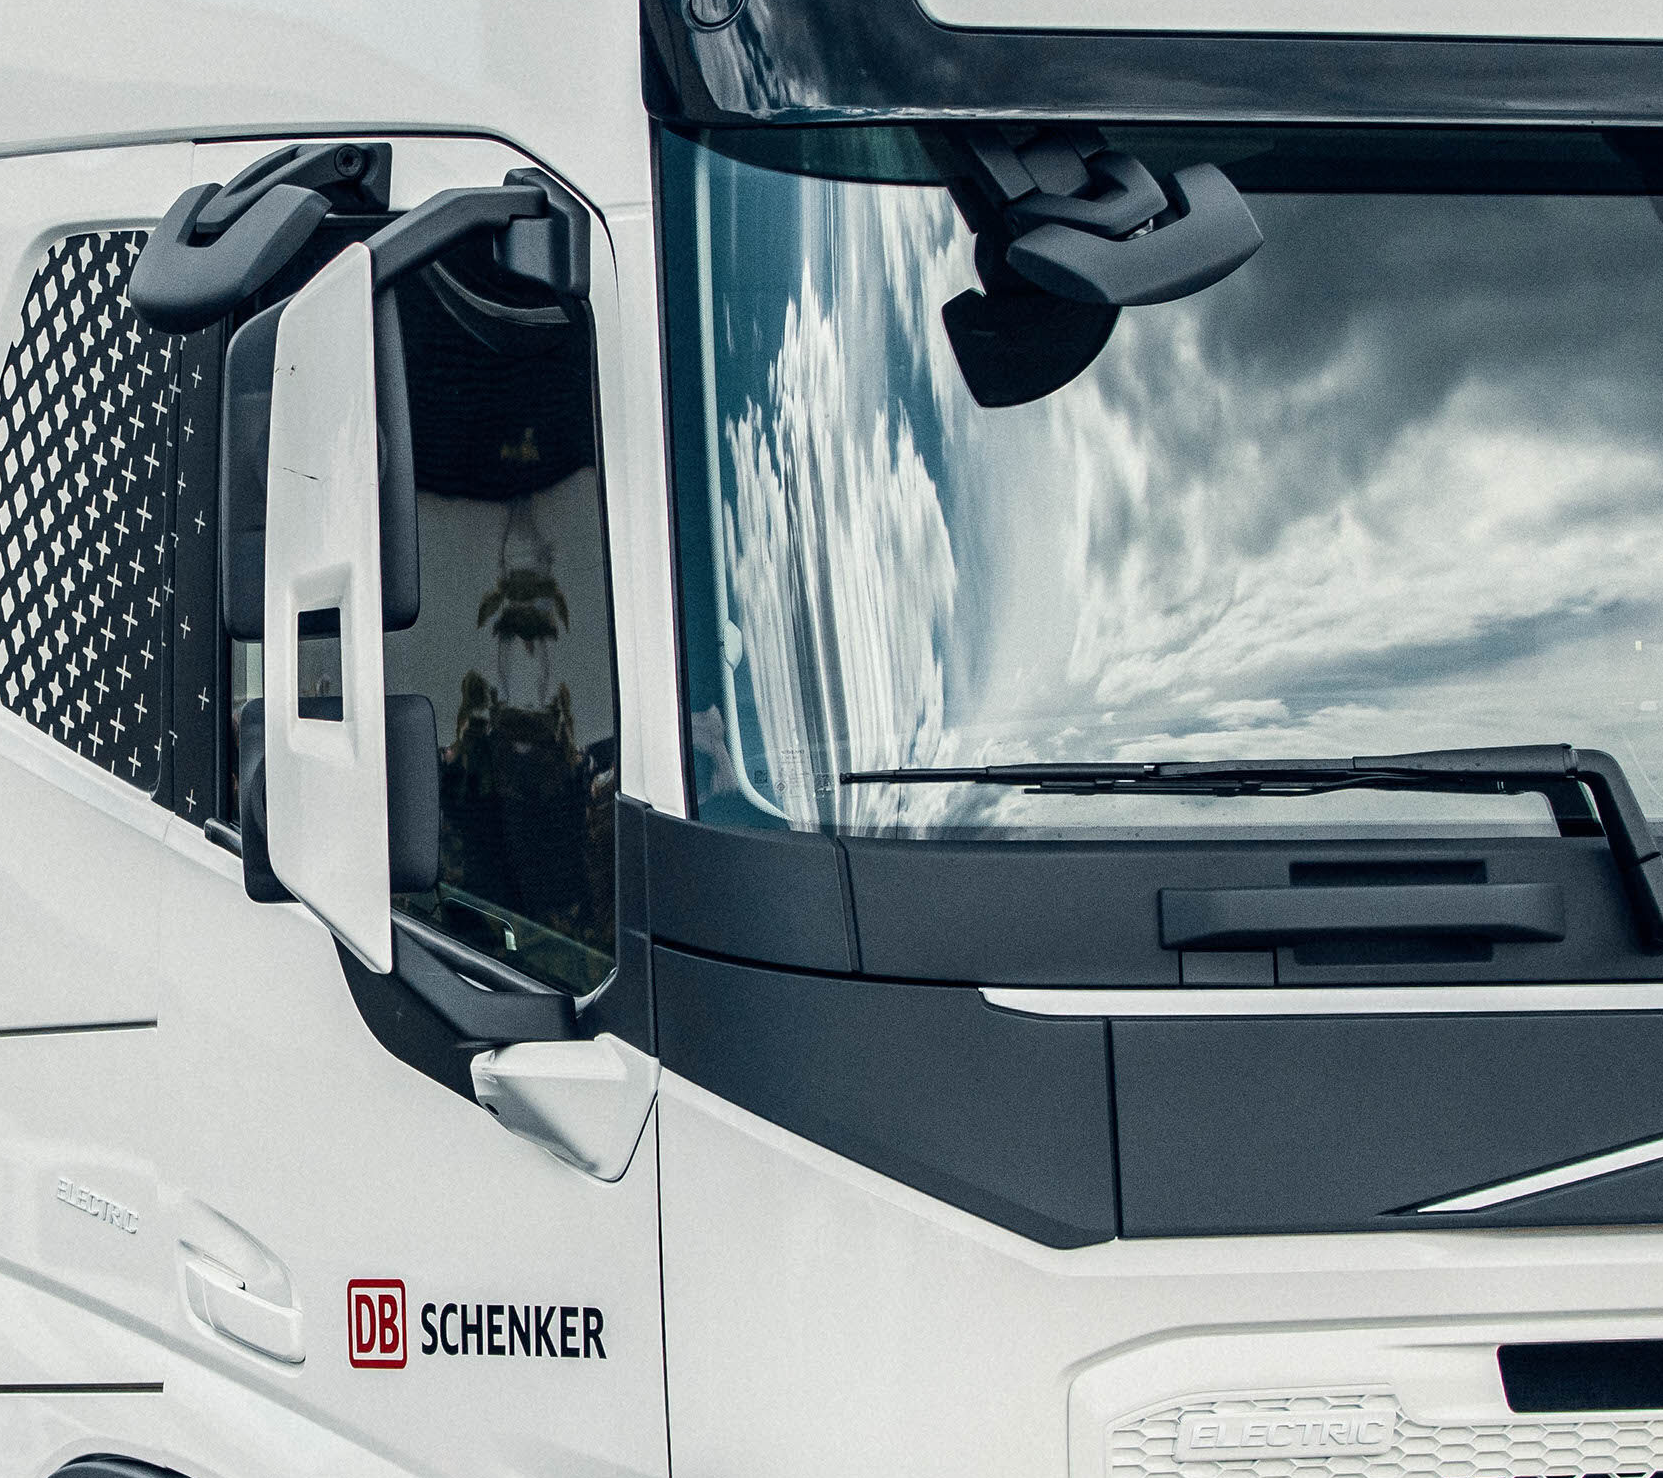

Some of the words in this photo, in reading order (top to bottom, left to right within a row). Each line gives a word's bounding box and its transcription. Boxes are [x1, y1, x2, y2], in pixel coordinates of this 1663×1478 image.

[56, 1177, 140, 1235] ELECTRIC
[355, 1292, 402, 1357] DB
[420, 1302, 608, 1360] SCHENKER
[1189, 1419, 1386, 1450] ELECTRIC
